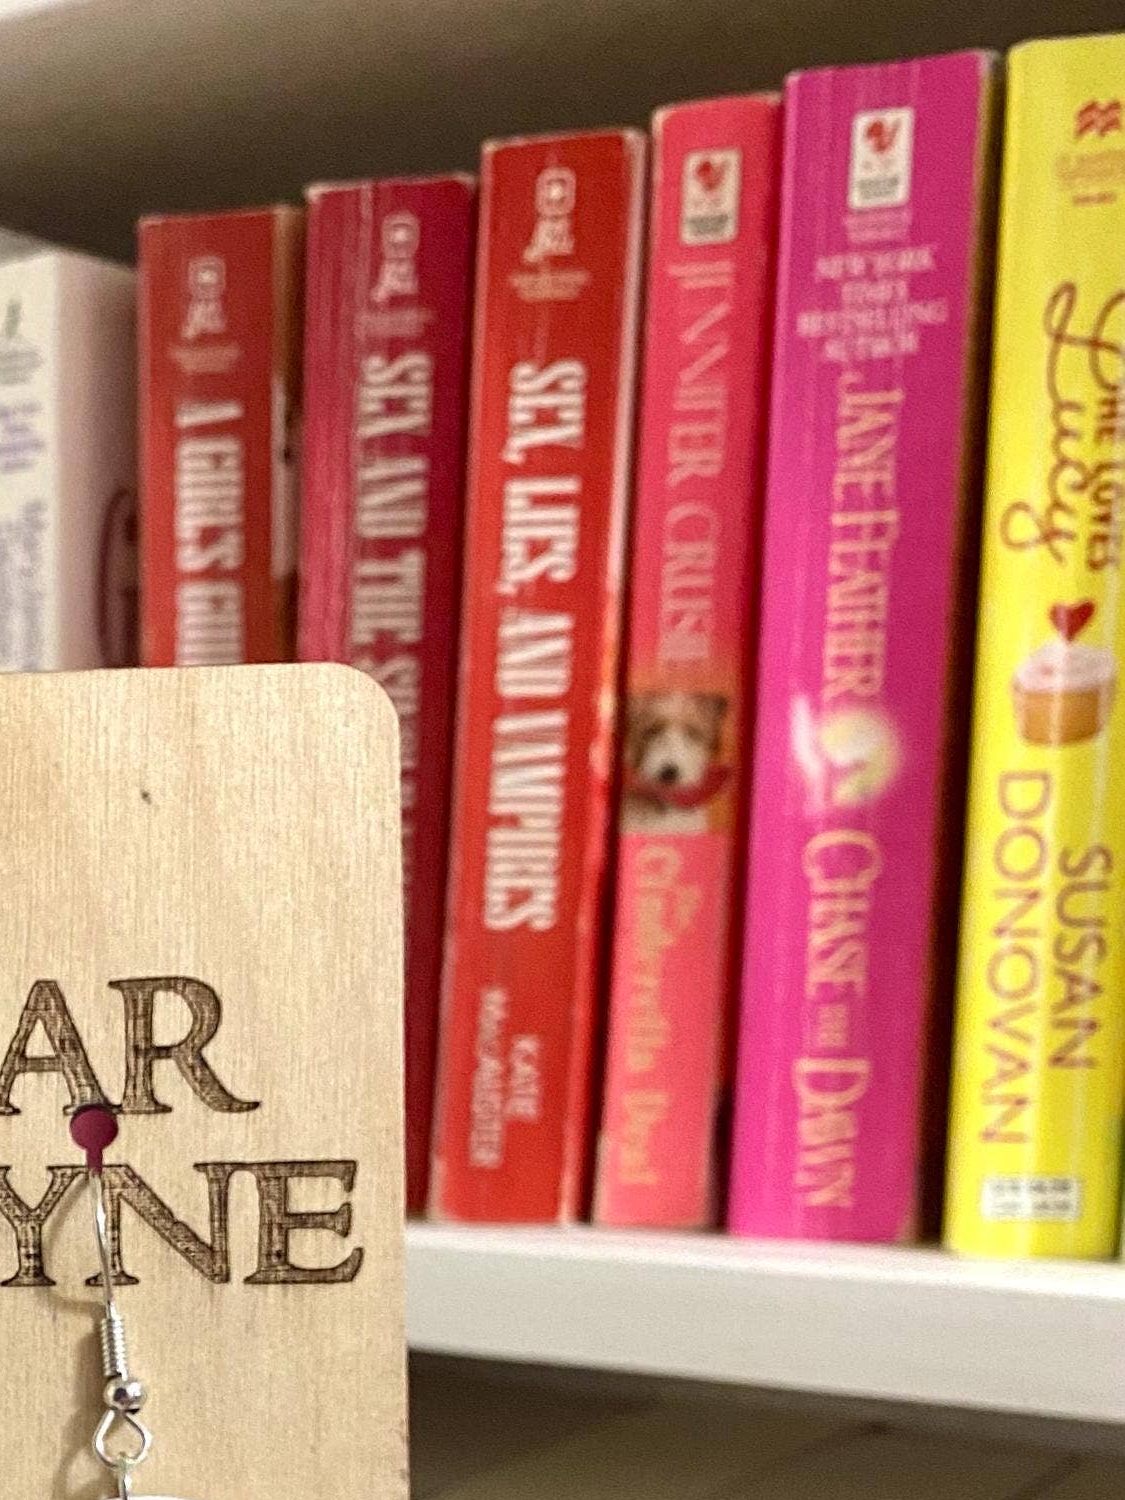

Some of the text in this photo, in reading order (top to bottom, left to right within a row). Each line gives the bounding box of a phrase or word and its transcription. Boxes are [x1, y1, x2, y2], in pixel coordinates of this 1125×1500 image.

[359, 350, 435, 437] SEX
[502, 357, 588, 464] SEX,
[353, 455, 432, 540] AND
[492, 474, 583, 598] LIES,
[820, 370, 908, 702] JANE FEATHER
[350, 549, 426, 645] THE
[492, 610, 577, 698] AND
[482, 709, 571, 932] VAMPIRES
[803, 829, 884, 999] CHASE
[978, 770, 1051, 1146] DONOVAN
[1045, 845, 1115, 1073] SUSAN
[791, 1056, 876, 1210] DAWN
